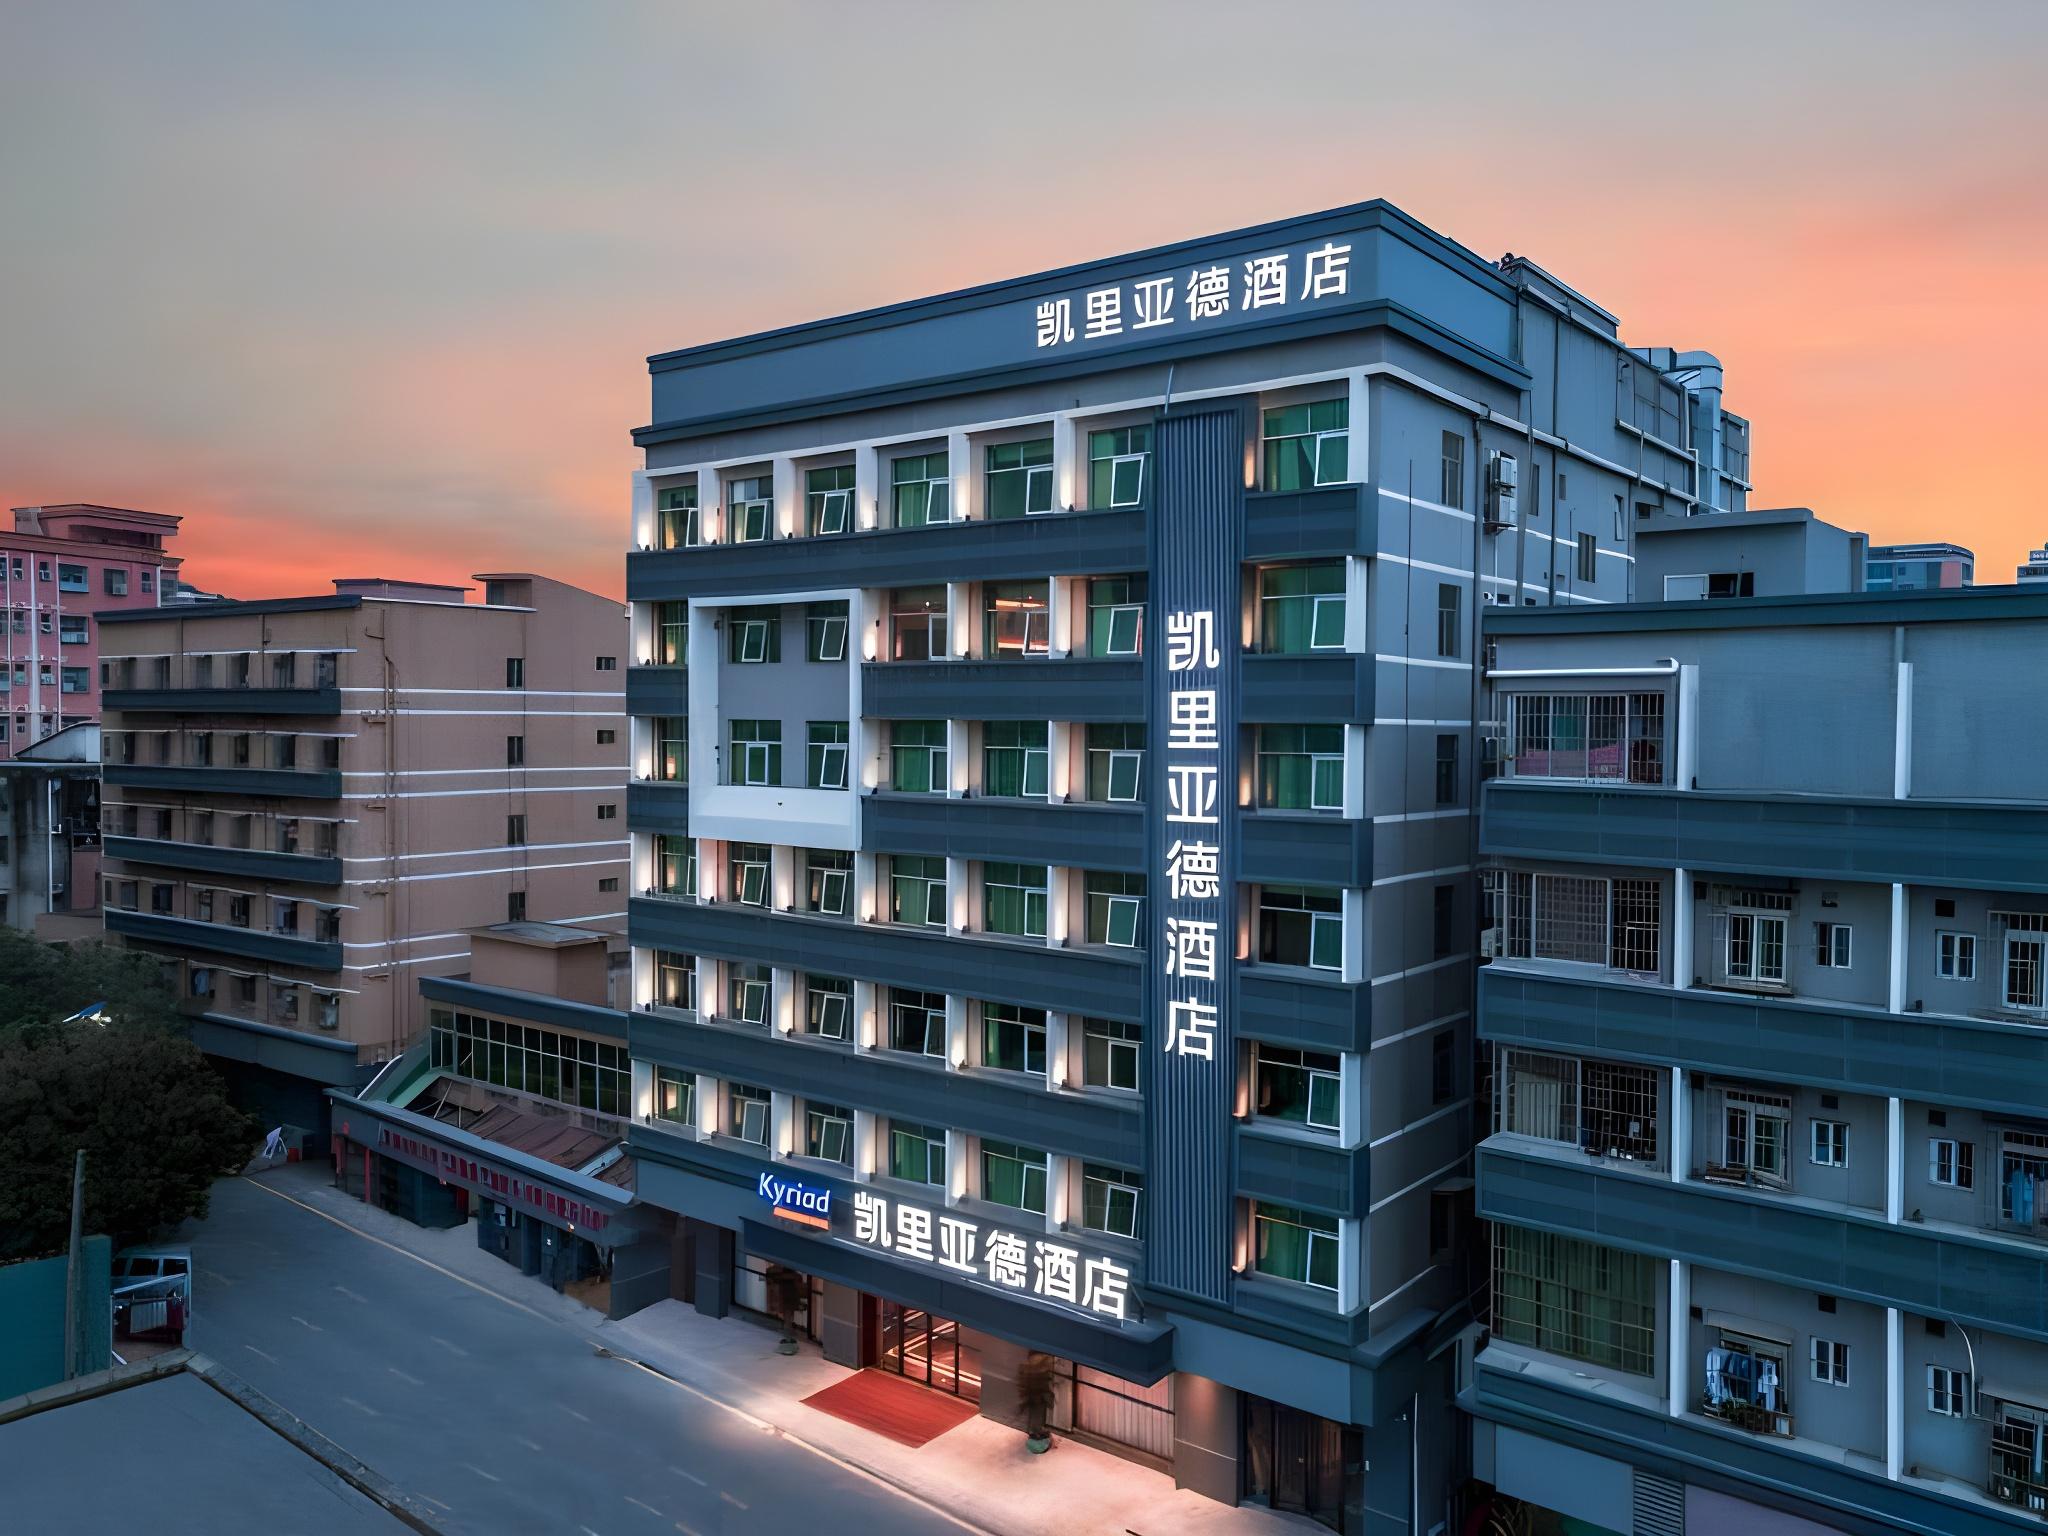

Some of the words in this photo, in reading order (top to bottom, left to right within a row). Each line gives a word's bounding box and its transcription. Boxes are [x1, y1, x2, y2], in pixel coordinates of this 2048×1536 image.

[1037, 243, 1351, 347] 凯里亚德酒店
[1165, 611, 1220, 1061] 凯里亚德酒店
[758, 1172, 831, 1213] Kyriad
[854, 1191, 1129, 1320] 凯里亚德酒店
